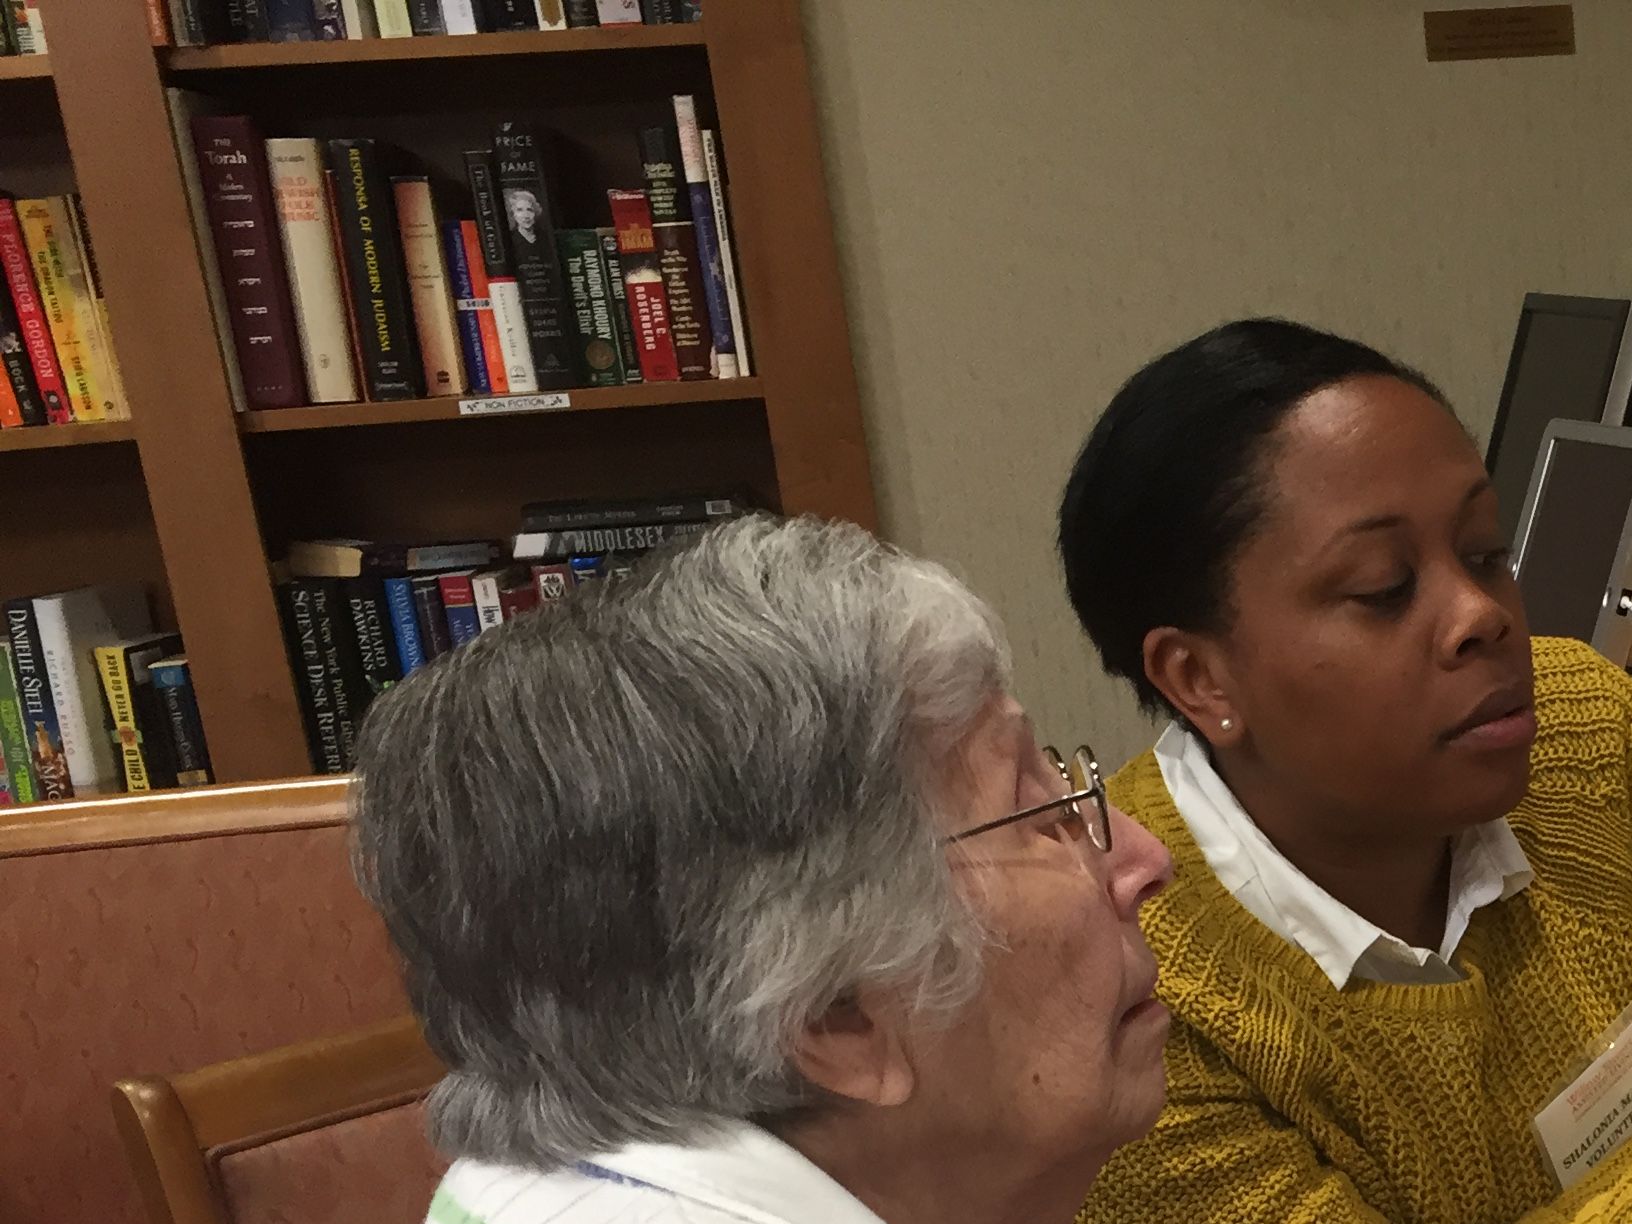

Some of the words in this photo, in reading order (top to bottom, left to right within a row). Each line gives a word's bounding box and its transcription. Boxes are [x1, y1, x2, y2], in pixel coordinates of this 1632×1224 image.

[204, 150, 248, 166] Torah
[495, 135, 533, 148] PRICE
[348, 147, 370, 212] RESPONSA
[501, 161, 536, 173] FAME
[359, 215, 373, 234] OF
[362, 237, 384, 294] MODERN
[567, 256, 582, 277] The
[583, 249, 604, 299] RAYMOND
[607, 258, 620, 277] ALAN
[2, 233, 35, 313] FLORENCE
[26, 317, 55, 378] GORDON
[571, 277, 589, 310] Devil's
[649, 296, 665, 323] JOEL
[370, 297, 393, 353] JUDAISM
[575, 307, 593, 336] Elixir
[591, 299, 612, 340] KHOURY
[633, 285, 658, 352] ROSENBERG
[484, 396, 506, 410] NON
[507, 396, 546, 409] FICTION
[573, 525, 664, 553] MIDDLESEX
[313, 589, 328, 614] The
[392, 583, 410, 623] SYLVIA
[8, 609, 36, 677] DANIELLE
[318, 614, 332, 644] New
[350, 598, 377, 672] DAWKINS
[363, 599, 389, 669] RICHARD
[105, 653, 122, 678] BACK
[292, 589, 319, 662] SCIENCE
[306, 663, 330, 709] DESK
[325, 646, 341, 676] York
[21, 675, 44, 714] STEEL
[111, 678, 124, 694] GO
[332, 678, 349, 721] Public
[113, 694, 130, 723] NEVER
[124, 748, 145, 782] CHILD
[1561, 1106, 1621, 1171] SHALONIA
